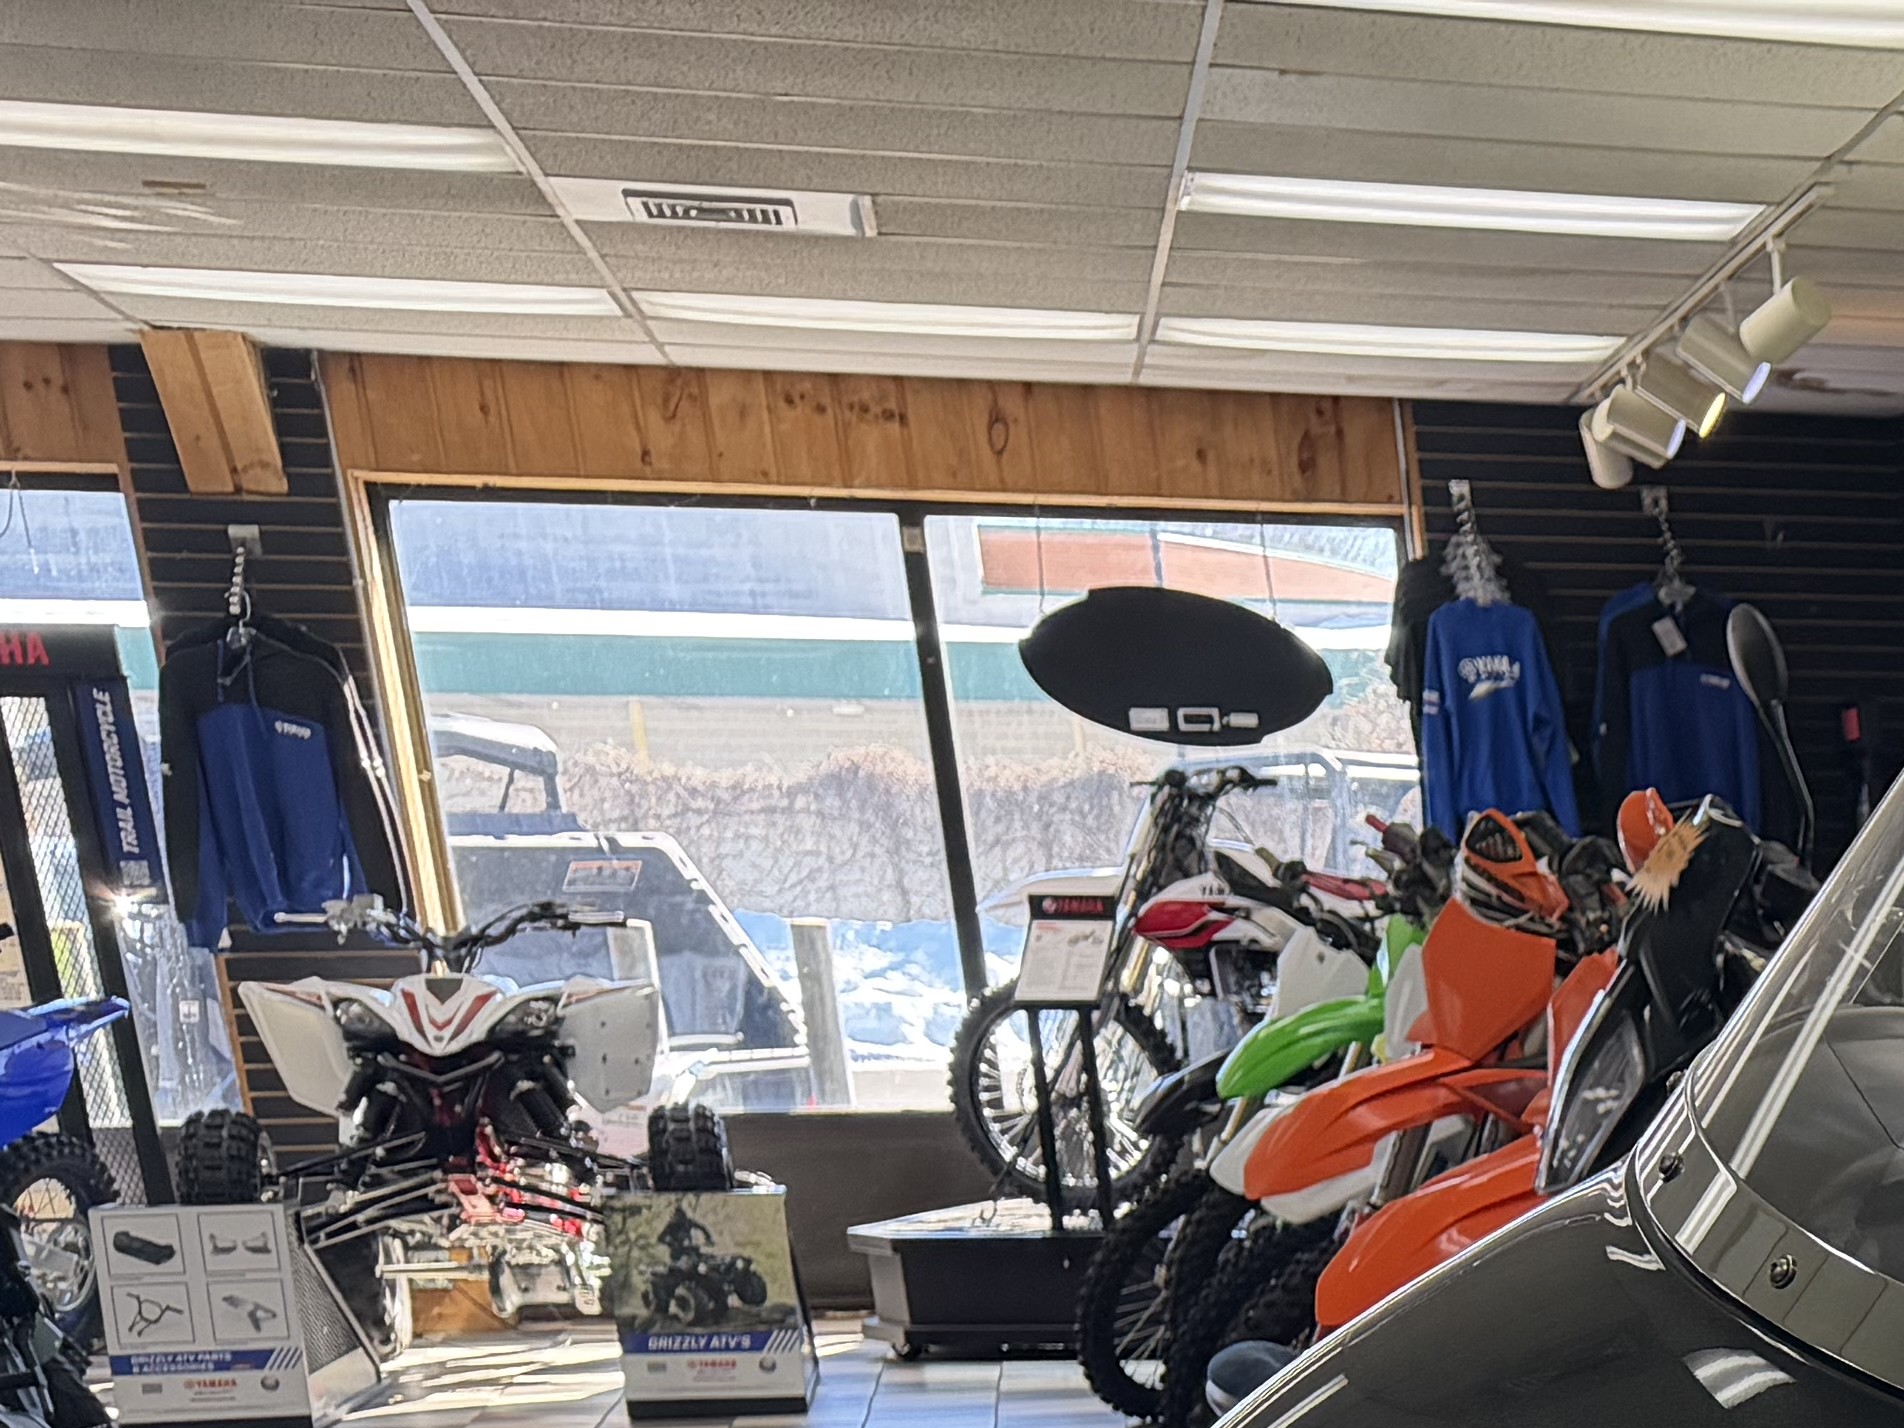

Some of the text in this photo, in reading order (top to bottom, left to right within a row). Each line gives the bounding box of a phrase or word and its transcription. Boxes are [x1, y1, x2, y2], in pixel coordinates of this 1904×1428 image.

[92, 687, 140, 855] TRAIL MOTORCYCLE
[648, 1334, 752, 1350] GRIZZLY ATV'S
